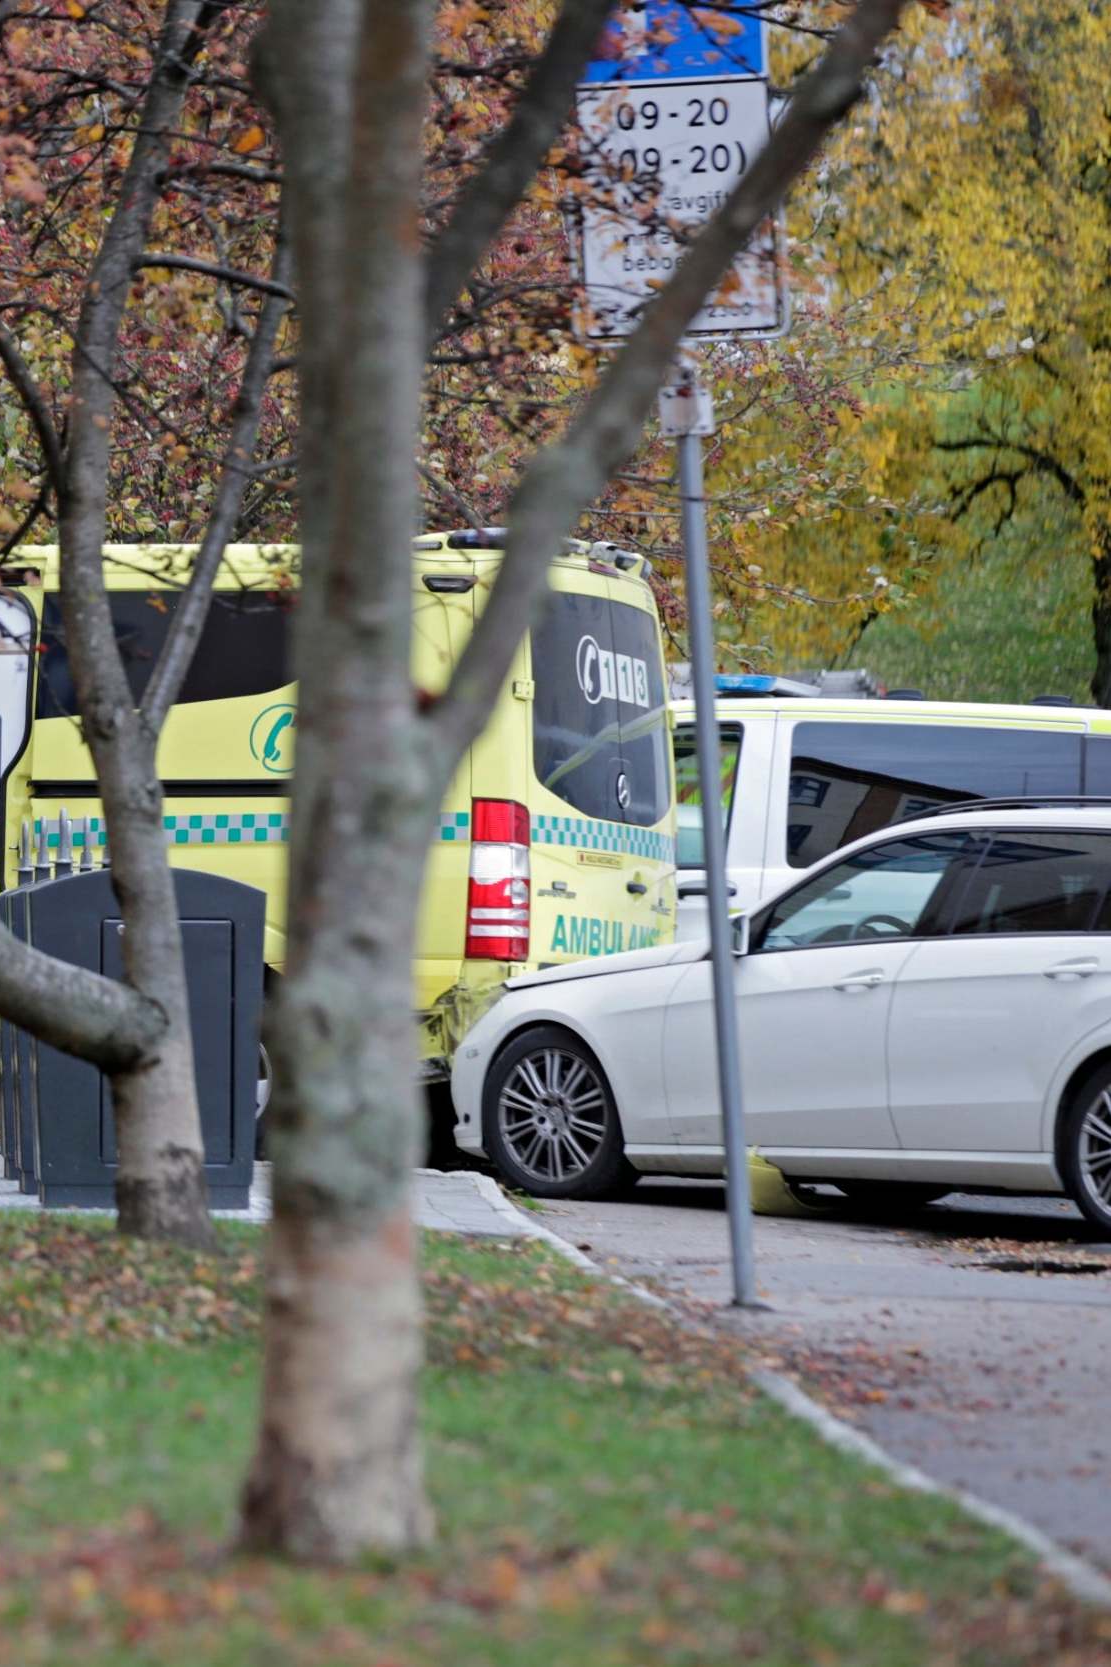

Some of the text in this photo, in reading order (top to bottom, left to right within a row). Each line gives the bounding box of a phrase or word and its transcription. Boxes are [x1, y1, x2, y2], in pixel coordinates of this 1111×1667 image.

[609, 140, 747, 176] 09-20)
[622, 254, 684, 272] beboe
[603, 656, 646, 702] 113
